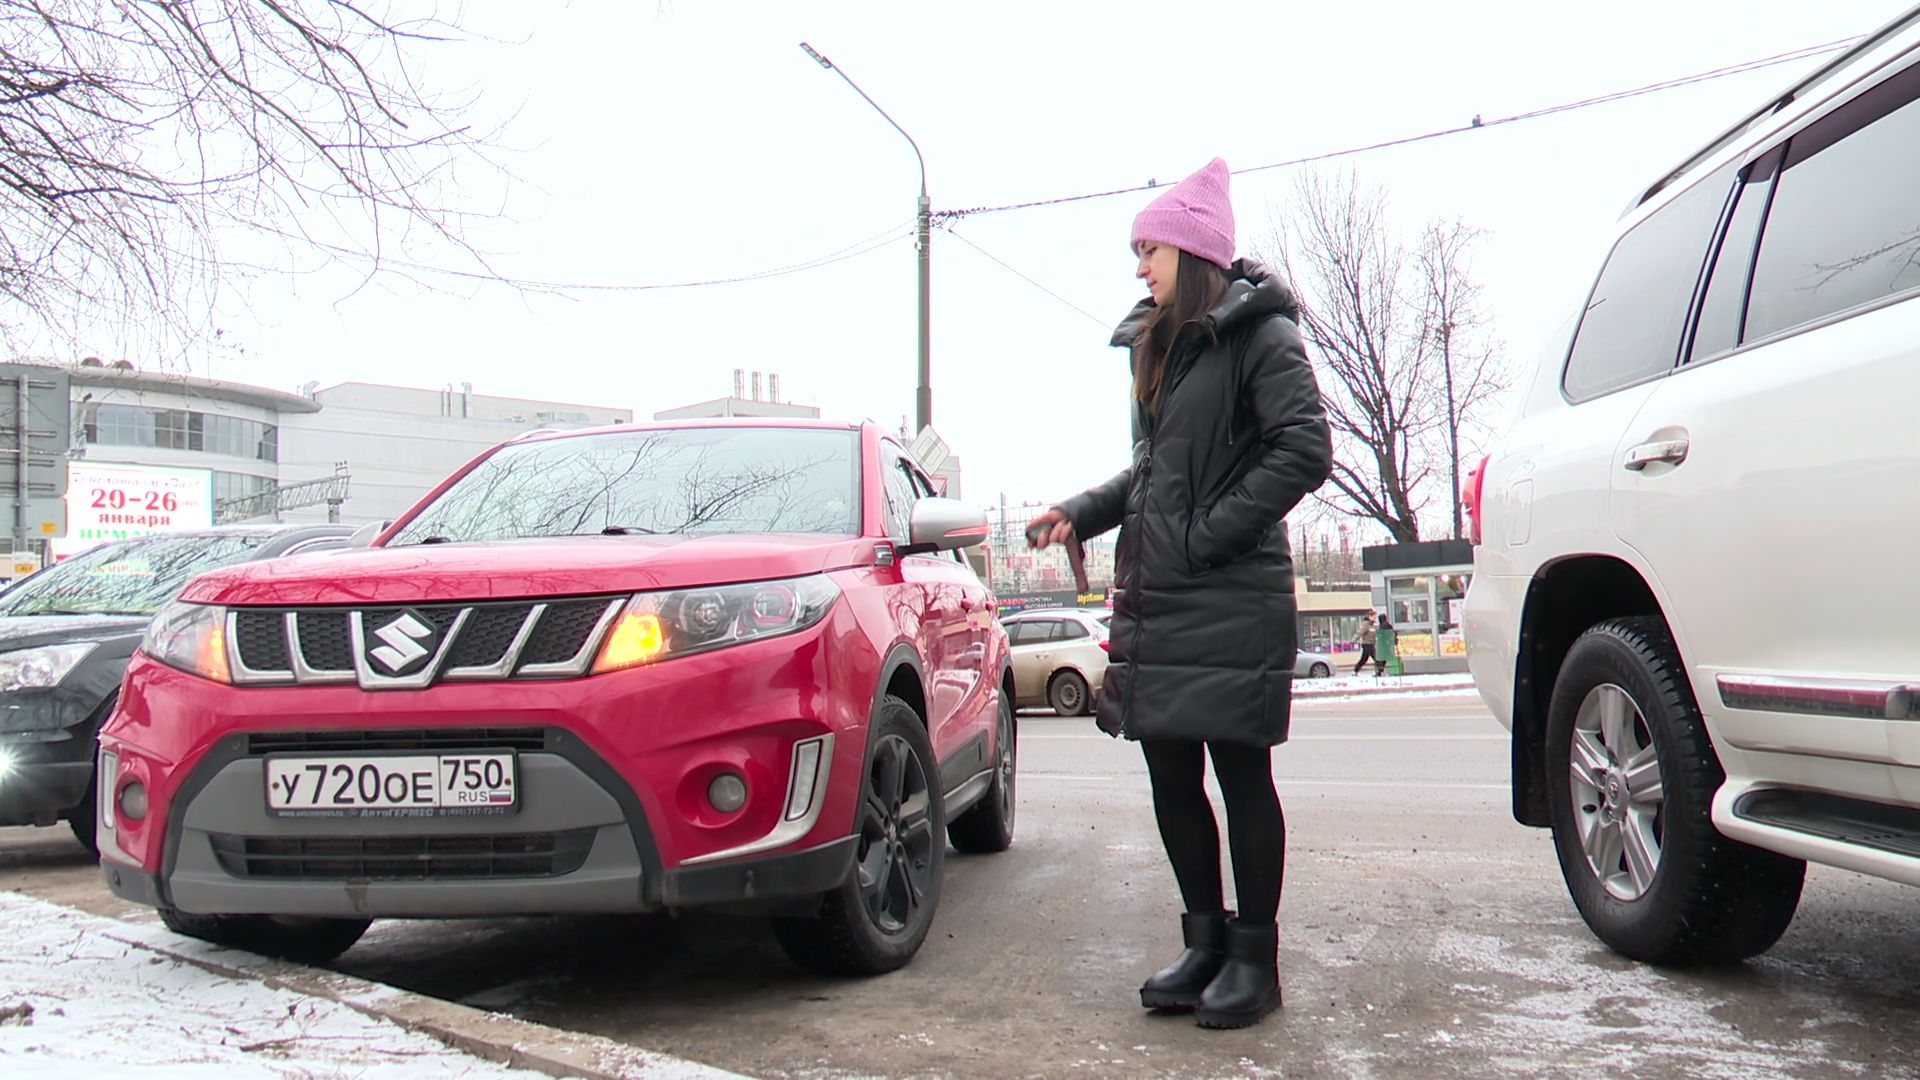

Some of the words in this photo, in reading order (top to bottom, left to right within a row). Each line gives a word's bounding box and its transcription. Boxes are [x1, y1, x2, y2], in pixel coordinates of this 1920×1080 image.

[91, 488, 177, 512] 20-26
[99, 514, 170, 527] января
[443, 759, 504, 791] 750
[458, 791, 488, 802] RUS
